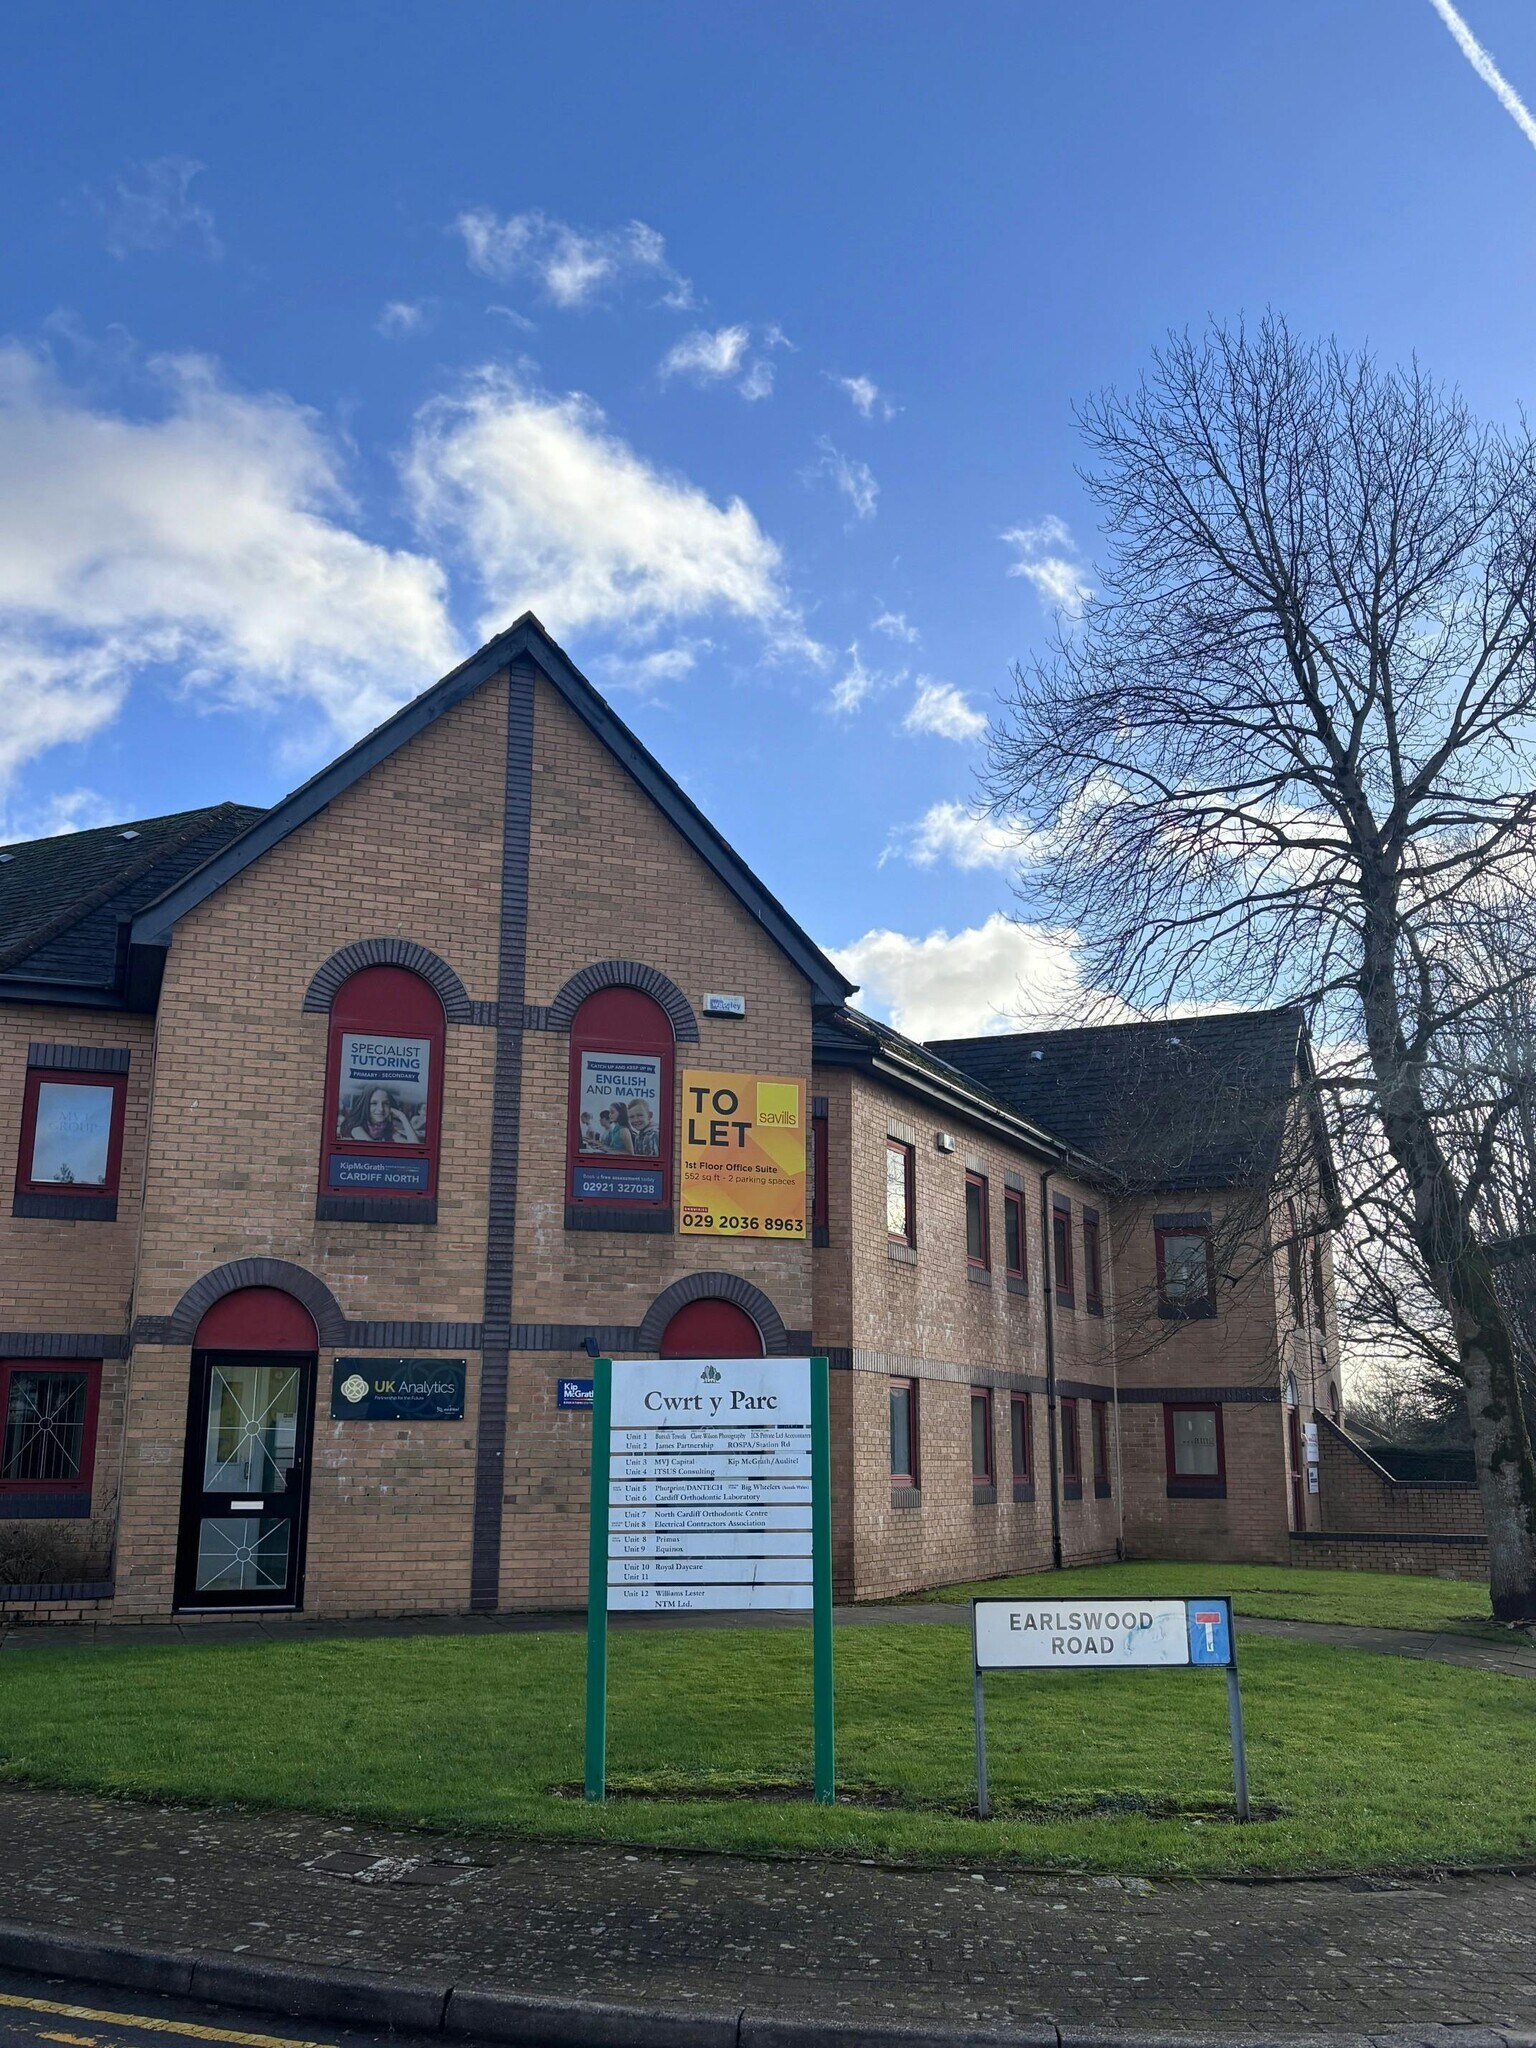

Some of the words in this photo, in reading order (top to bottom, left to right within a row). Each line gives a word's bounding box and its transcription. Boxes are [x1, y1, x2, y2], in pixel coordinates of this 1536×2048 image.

[351, 1043, 421, 1057] SPECIALIST
[351, 1054, 420, 1069] TUTORING
[596, 1074, 646, 1087] ENGLISH
[586, 1085, 612, 1095] AND
[615, 1087, 655, 1098] MATHS
[689, 1087, 739, 1116] TO
[759, 1111, 797, 1125] savills
[688, 1118, 752, 1148] LET
[685, 1161, 697, 1169] 1st
[699, 1161, 723, 1171] Floor
[725, 1163, 753, 1173] Office
[755, 1165, 778, 1174] Suite
[339, 1172, 382, 1182] CARDIFF
[384, 1174, 420, 1183] NORTH
[684, 1172, 700, 1181] 552
[713, 1173, 721, 1181] ft
[735, 1175, 766, 1185] parking
[768, 1177, 796, 1186] spaces
[583, 1182, 614, 1192] 02921
[617, 1183, 655, 1194] 327038
[683, 1214, 714, 1228] 029
[719, 1216, 760, 1230] 2036
[764, 1217, 803, 1232] 8963
[374, 1381, 395, 1393] UK
[398, 1380, 455, 1396] Analytics
[564, 1383, 578, 1392] Kip
[644, 1391, 703, 1411] Cwrt
[709, 1396, 723, 1417] y
[729, 1390, 778, 1410] Parc
[676, 1442, 714, 1450] Partnership
[671, 1458, 695, 1466] Capital
[727, 1458, 740, 1467] Kip
[678, 1468, 715, 1476] Consulting
[741, 1484, 752, 1492] Big
[723, 1493, 761, 1502] Laboratory
[655, 1546, 683, 1554] Equinox
[655, 1563, 674, 1572] Royal
[675, 1563, 703, 1572] Daycare
[1009, 1612, 1154, 1631] EARLSWOOD
[1051, 1636, 1115, 1655] ROAD
